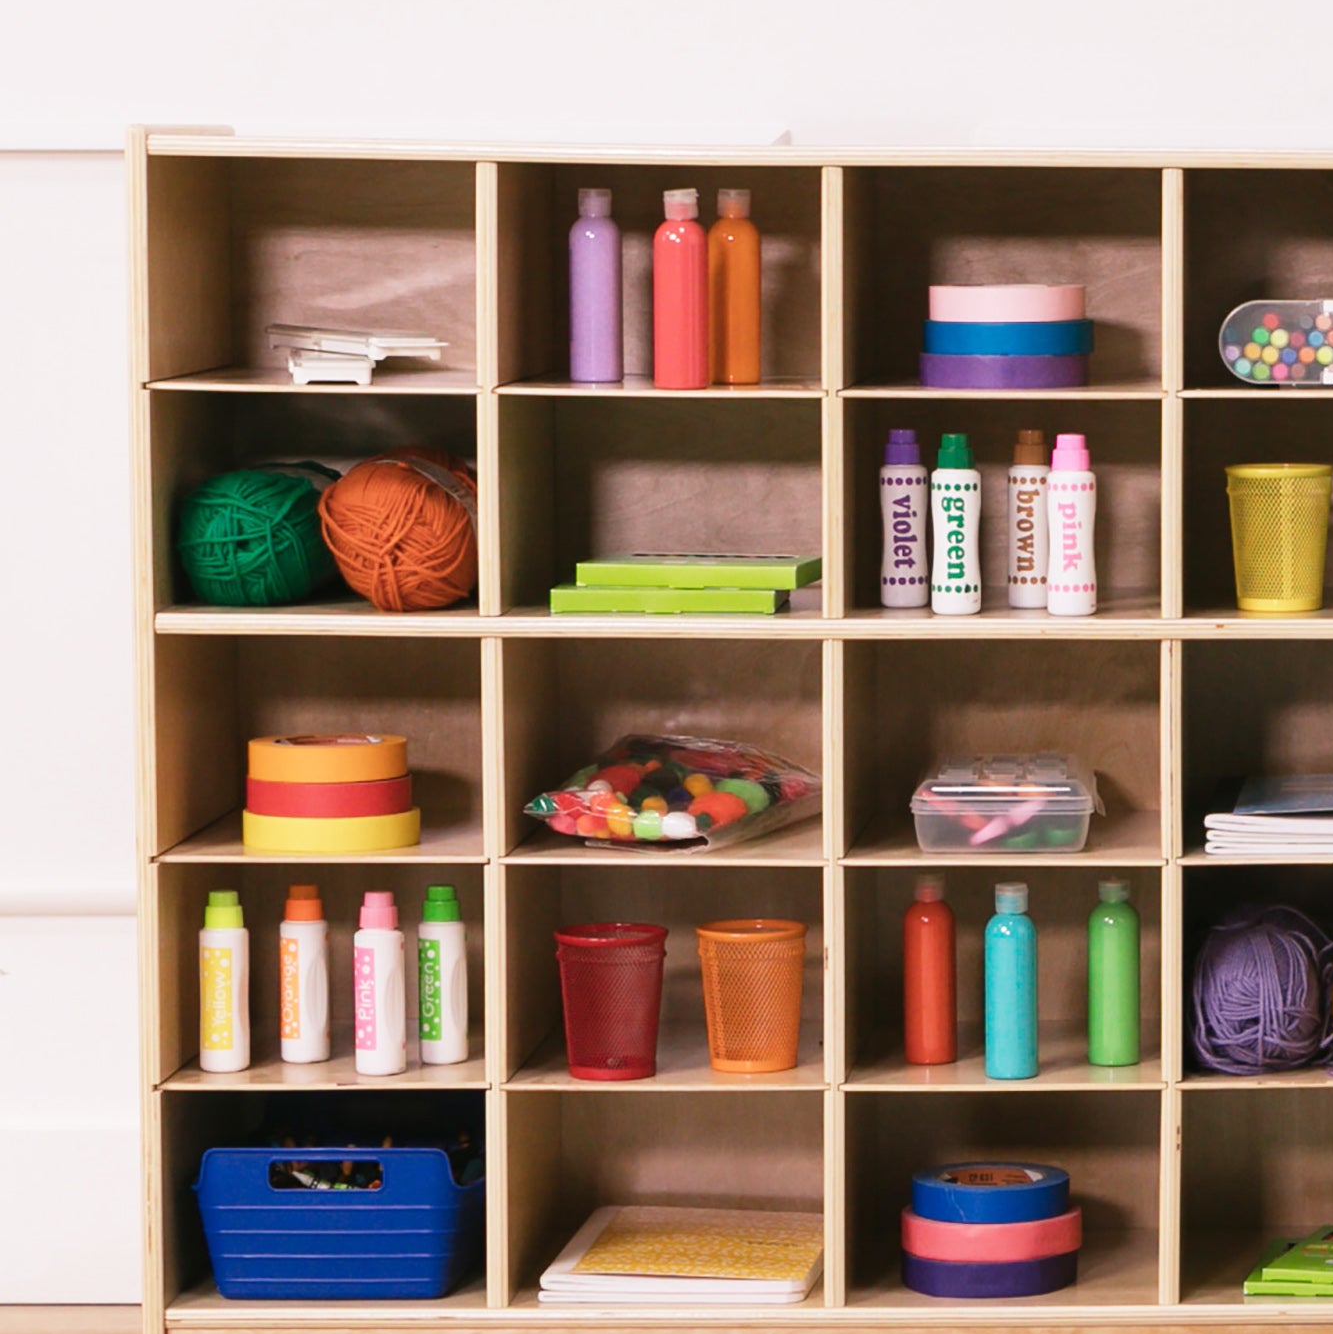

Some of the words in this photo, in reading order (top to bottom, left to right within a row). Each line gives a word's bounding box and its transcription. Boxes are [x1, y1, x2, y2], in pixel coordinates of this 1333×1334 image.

[892, 494, 918, 569] violet
[941, 496, 966, 580] green
[1016, 489, 1040, 572] brown
[1058, 502, 1082, 572] pink
[212, 970, 227, 1027] Yellow
[282, 955, 296, 1022] Orange
[358, 978, 375, 1021] Pink
[422, 960, 437, 1017] Green
